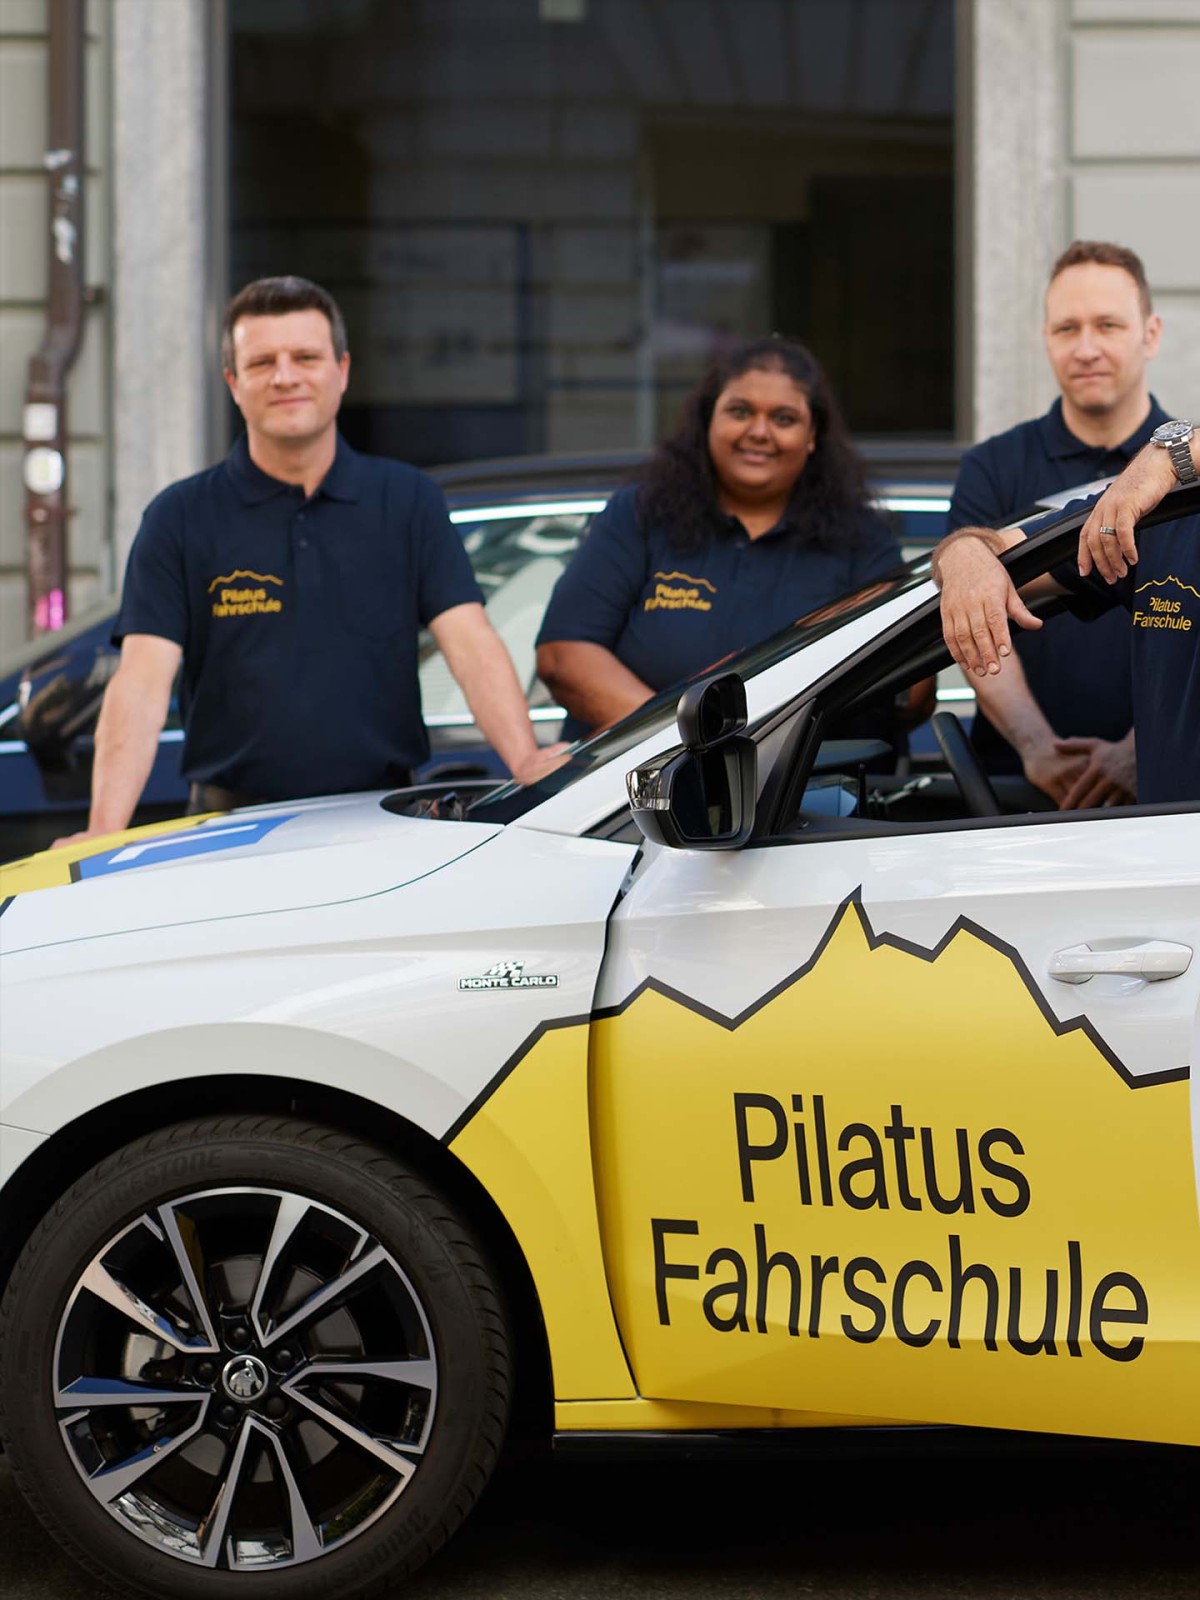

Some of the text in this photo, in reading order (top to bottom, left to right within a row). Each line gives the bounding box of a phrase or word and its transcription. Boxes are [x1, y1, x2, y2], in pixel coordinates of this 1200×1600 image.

[221, 588, 266, 603] Pilatus
[655, 584, 699, 600] Pilatus
[1149, 597, 1181, 613] Pilatus
[1133, 611, 1192, 631] Farschule
[461, 976, 557, 988] MONTE CARLO
[733, 1092, 1031, 1218] Pilatus
[650, 1217, 1149, 1363] Fahrschule
